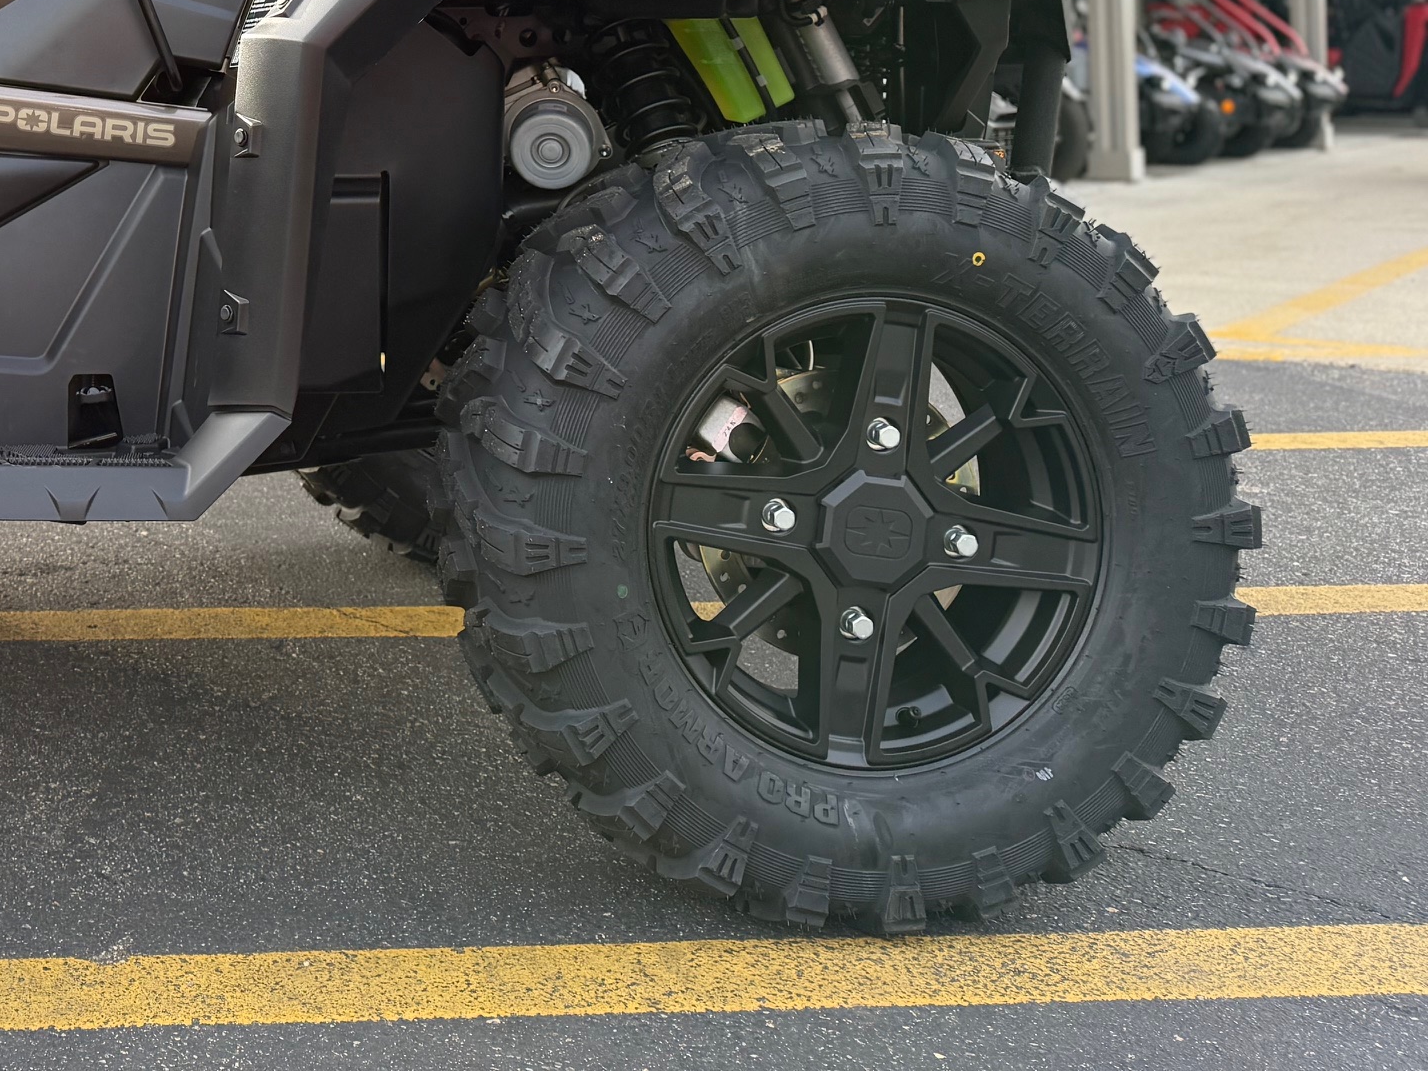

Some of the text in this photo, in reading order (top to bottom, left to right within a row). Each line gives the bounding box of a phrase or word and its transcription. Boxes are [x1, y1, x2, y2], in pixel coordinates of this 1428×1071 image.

[931, 252, 1157, 458] X-TERRAIN
[639, 650, 840, 826] PRO ARMOR
